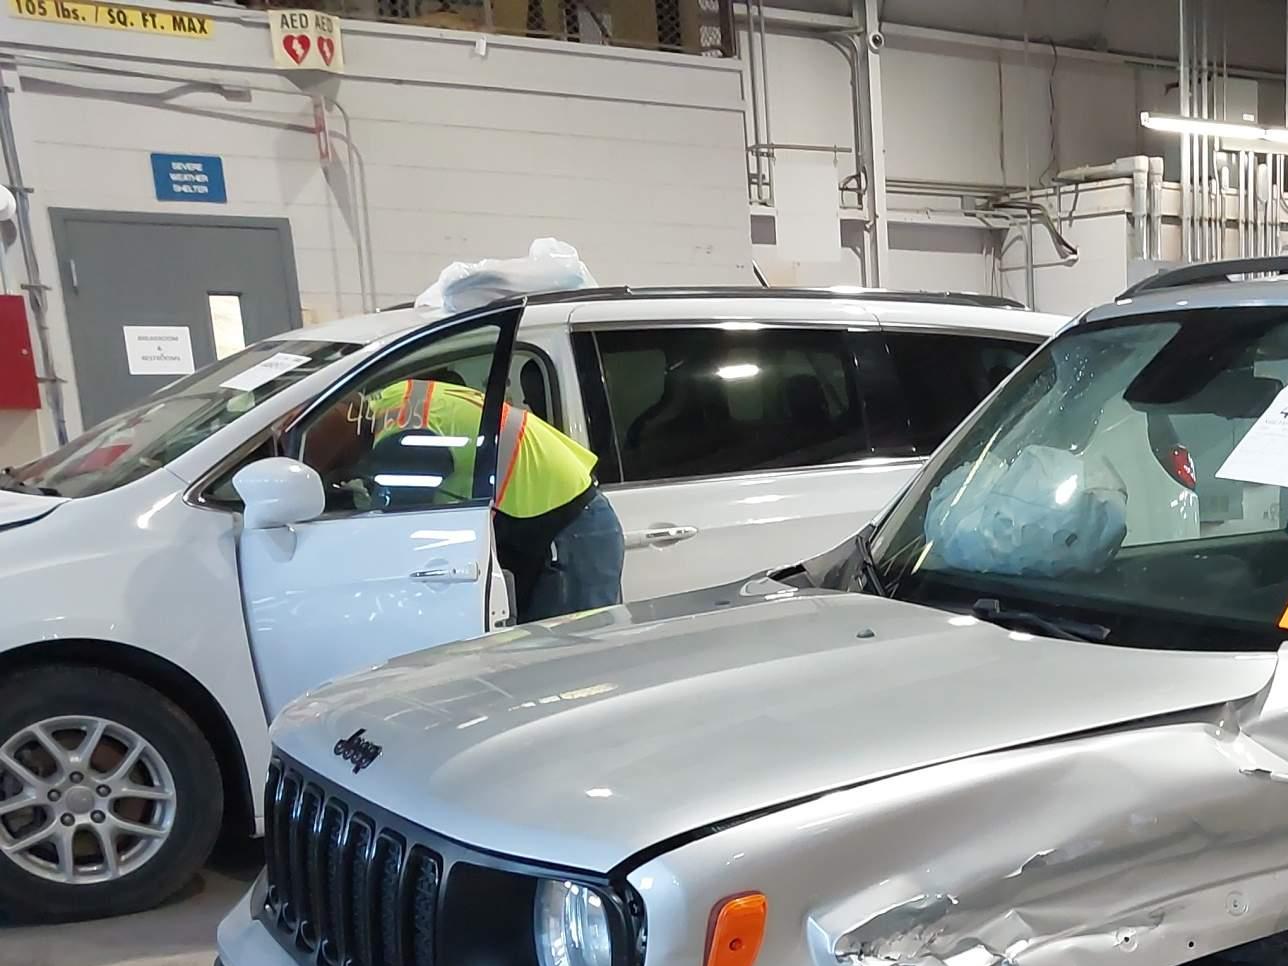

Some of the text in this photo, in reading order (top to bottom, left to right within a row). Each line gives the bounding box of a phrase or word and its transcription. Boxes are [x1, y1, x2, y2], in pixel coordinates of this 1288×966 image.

[16, 0, 48, 17] 105
[54, 1, 86, 21] lbs.
[107, 9, 135, 27] SQ.
[140, 12, 165, 30] FT.
[172, 15, 208, 35] MAX
[280, 13, 309, 29] AED
[314, 14, 334, 33] AED
[168, 172, 209, 183] WEATHER
[172, 183, 209, 194] SHELTER
